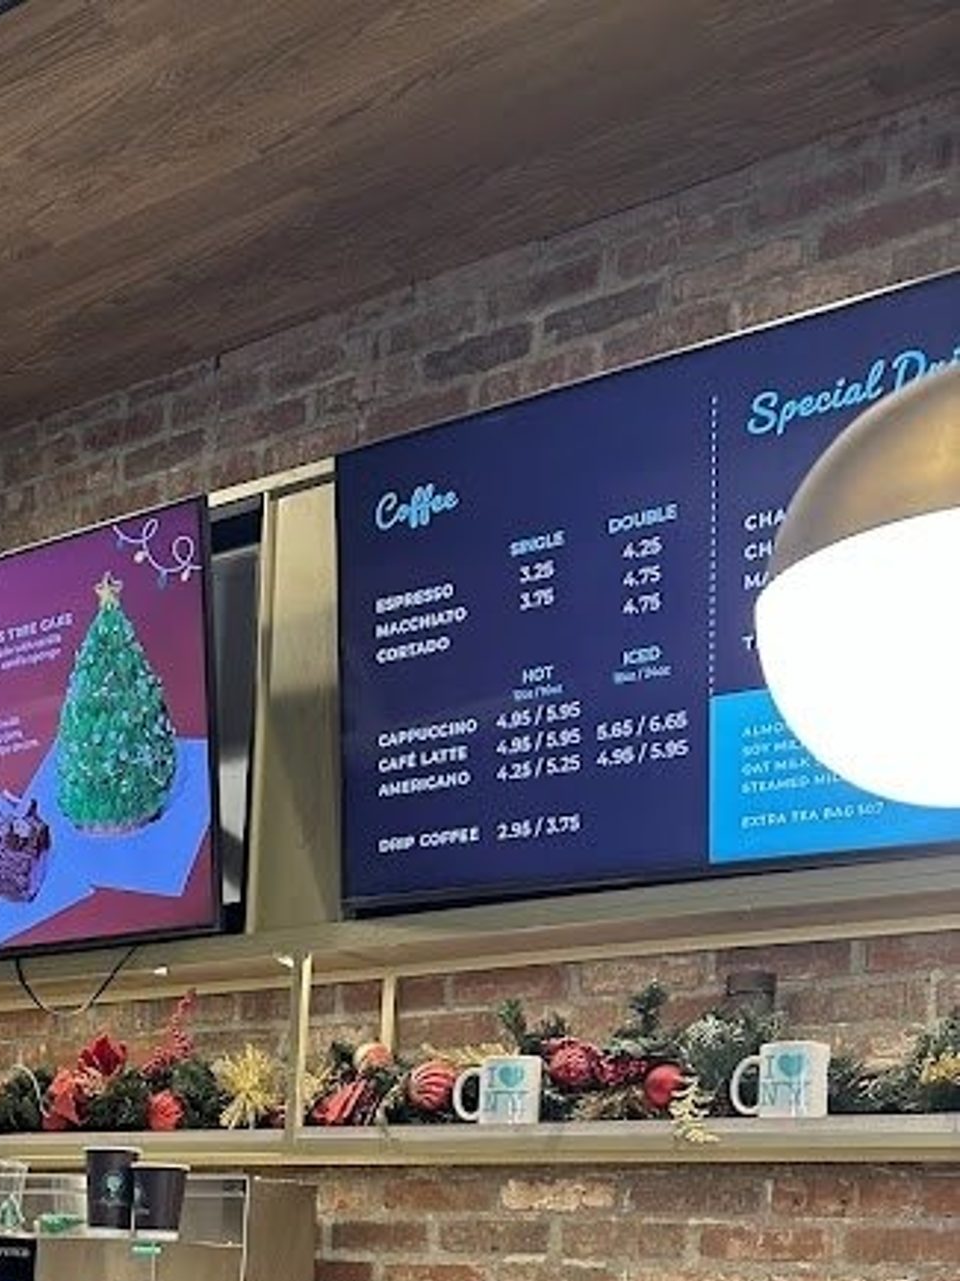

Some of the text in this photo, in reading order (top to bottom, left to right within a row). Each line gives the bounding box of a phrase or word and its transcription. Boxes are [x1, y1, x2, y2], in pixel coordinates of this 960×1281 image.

[747, 360, 885, 435] Special
[375, 484, 459, 529] Coffee
[744, 508, 786, 531] CHA
[510, 504, 678, 556] SINGLE DOUBLE
[744, 540, 772, 560] CH
[375, 537, 662, 614] ESPRESSO 3.25 4.25
[375, 565, 662, 638] MACCHIATO 3.75 4.75
[375, 593, 662, 664] CORTADO 4.75
[522, 645, 661, 684] HOT ICED
[378, 718, 478, 748] CAPPUCCINO
[742, 722, 784, 737] ALMO
[378, 750, 417, 773] CAFÉ
[420, 746, 468, 767] LATTE
[774, 740, 799, 752] MIL
[378, 771, 471, 798] AMERICANO
[741, 773, 841, 793] STEAMED MIL
[741, 813, 787, 829] EXTRA
[792, 809, 819, 821] TEA
[378, 834, 415, 854] DRIP
[419, 827, 481, 848] COFFEE
